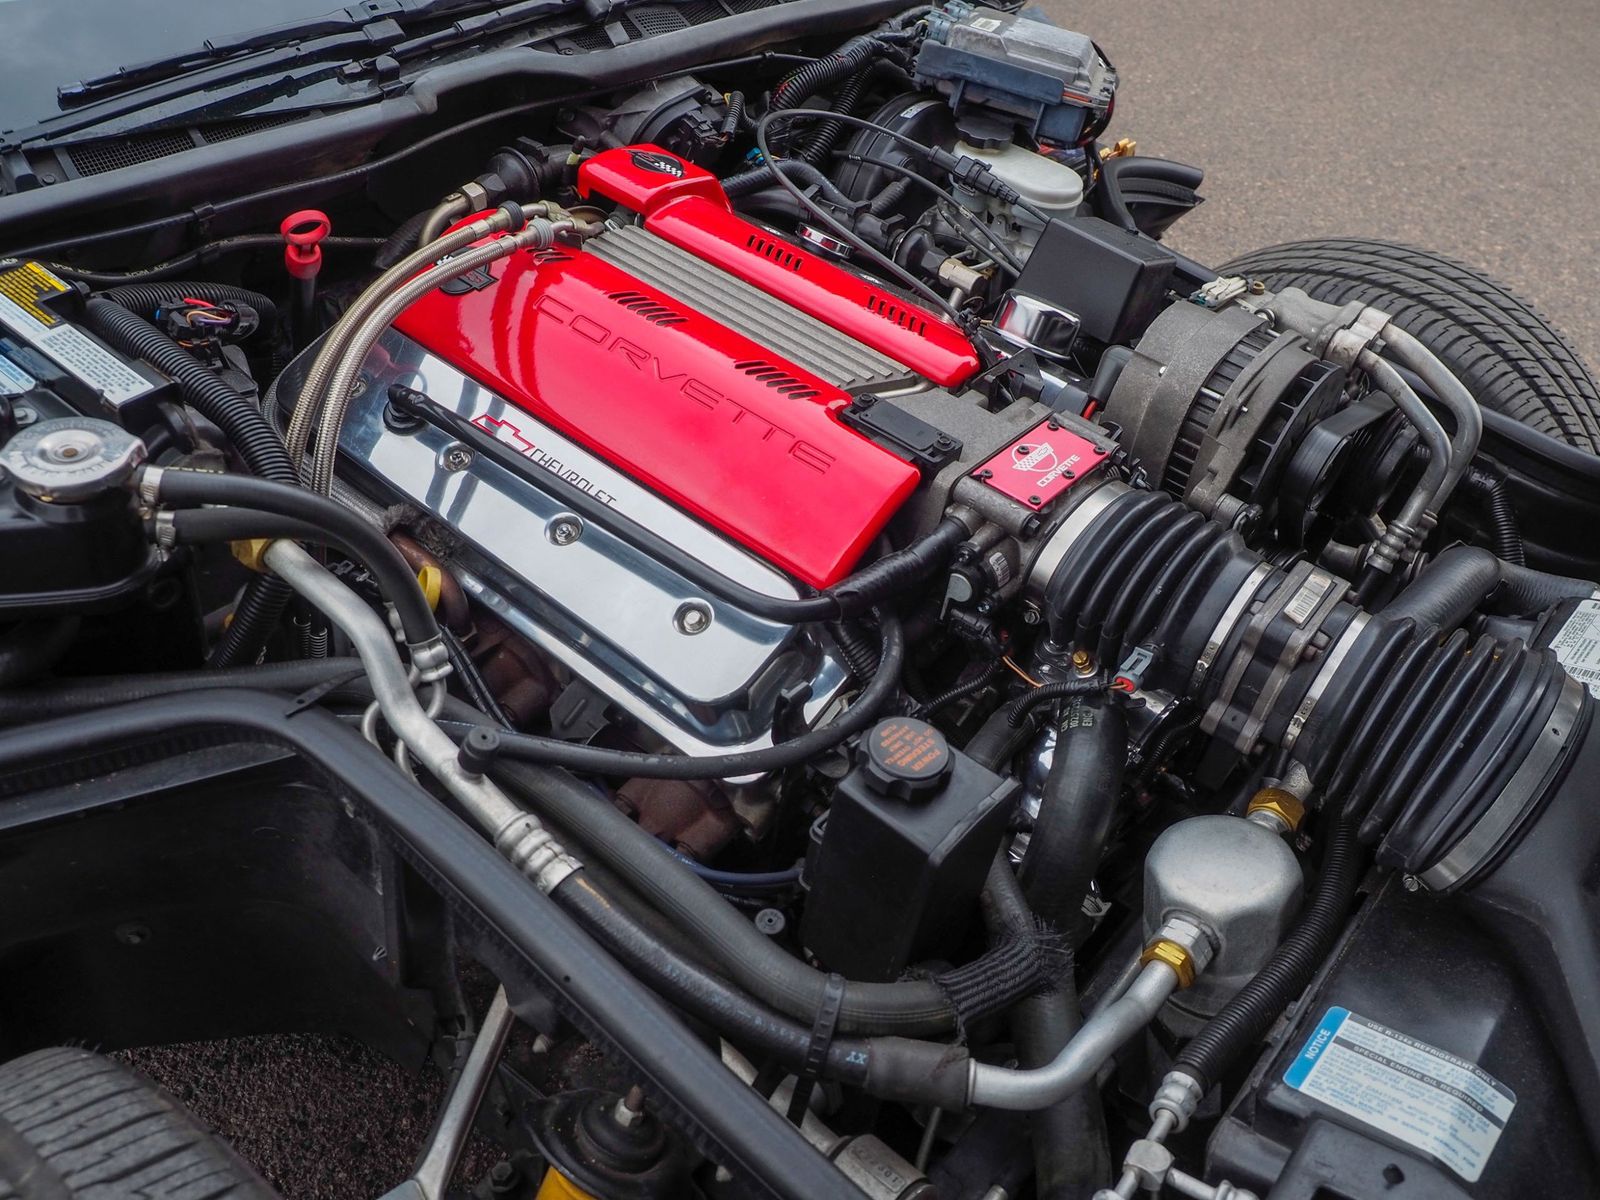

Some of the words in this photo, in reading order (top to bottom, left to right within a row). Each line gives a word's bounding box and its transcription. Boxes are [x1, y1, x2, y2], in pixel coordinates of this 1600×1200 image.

[533, 294, 837, 475] CORVETTE
[530, 449, 617, 504] CHEVROLET
[1036, 454, 1080, 487] CORVETTE
[897, 737, 935, 767] STEERING
[910, 748, 941, 772] POWER
[1304, 1028, 1332, 1060] NOTICE
[1367, 1021, 1384, 1032] USE
[1414, 1042, 1474, 1071] REFRIGERANT
[1475, 1068, 1497, 1087] ONLY
[1354, 1045, 1388, 1066] SPECIAL
[1389, 1061, 1421, 1080] ENGINE
[1423, 1075, 1438, 1087] OIL
[1439, 1083, 1484, 1113] REQUIRED
